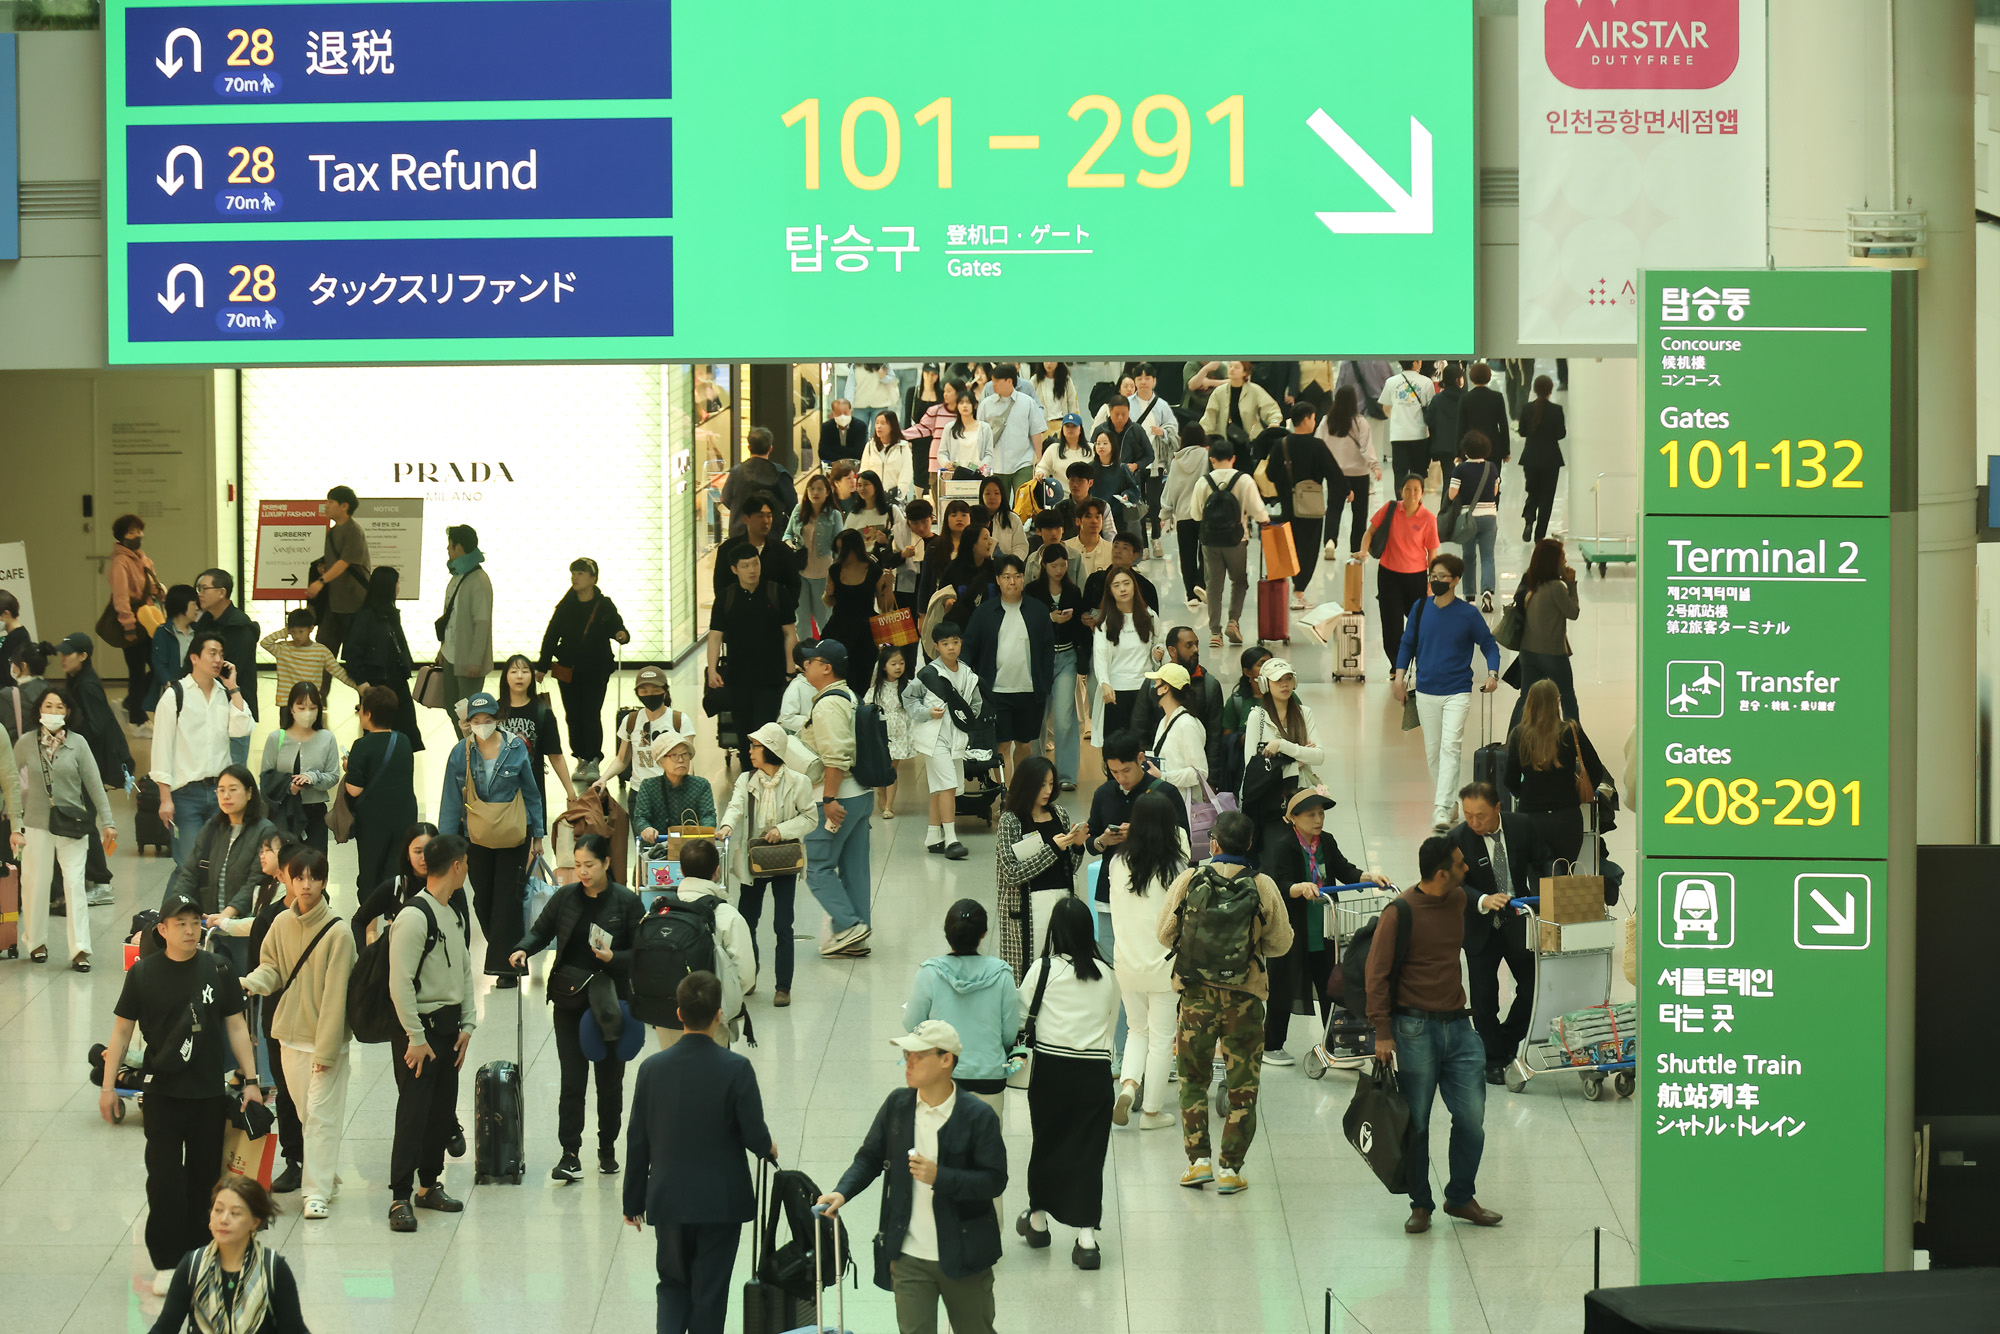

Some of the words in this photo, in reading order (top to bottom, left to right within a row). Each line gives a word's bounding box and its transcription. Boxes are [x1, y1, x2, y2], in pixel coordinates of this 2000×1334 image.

[1575, 21, 1709, 49] AIRSTAR
[226, 28, 275, 67] 28
[305, 29, 395, 76] 退税
[224, 76, 259, 93] 70m
[1546, 109, 1738, 135] 인천공항면세점앱
[226, 146, 276, 185] 28
[308, 154, 380, 192] Tax
[390, 148, 537, 192] Refund
[225, 193, 260, 211] 70m
[785, 223, 921, 273] 탑승구
[946, 258, 1003, 278] Gates
[227, 264, 277, 303] 28
[308, 271, 577, 307] タックスリファンド
[1661, 285, 1751, 322] 탑승동
[226, 311, 261, 329] 70m
[1660, 336, 1742, 352] Concourse
[1661, 354, 1706, 371] 候机楼
[1661, 373, 1722, 387] コンコース
[1659, 406, 1730, 429] Gates
[393, 462, 514, 483] PRADA
[1659, 439, 1864, 489] 101-132
[373, 505, 400, 513] NOTICE
[1667, 539, 1826, 574] Terminal
[1838, 541, 1860, 574] 2
[1667, 586, 1751, 602] 제2여객터미널
[1666, 620, 1791, 635] 第2旅客ターミナル
[1735, 669, 1841, 694] Transfer
[1664, 742, 1732, 765] Gates
[1664, 776, 1861, 827] 208-291
[1657, 967, 1774, 998] 셔틀트레인
[1658, 1003, 1705, 1033] 타는
[1710, 1004, 1735, 1033] 곳
[1656, 1053, 1738, 1075] Shuttle
[1742, 1054, 1802, 1076] Train
[1656, 1082, 1760, 1111] 航站列车
